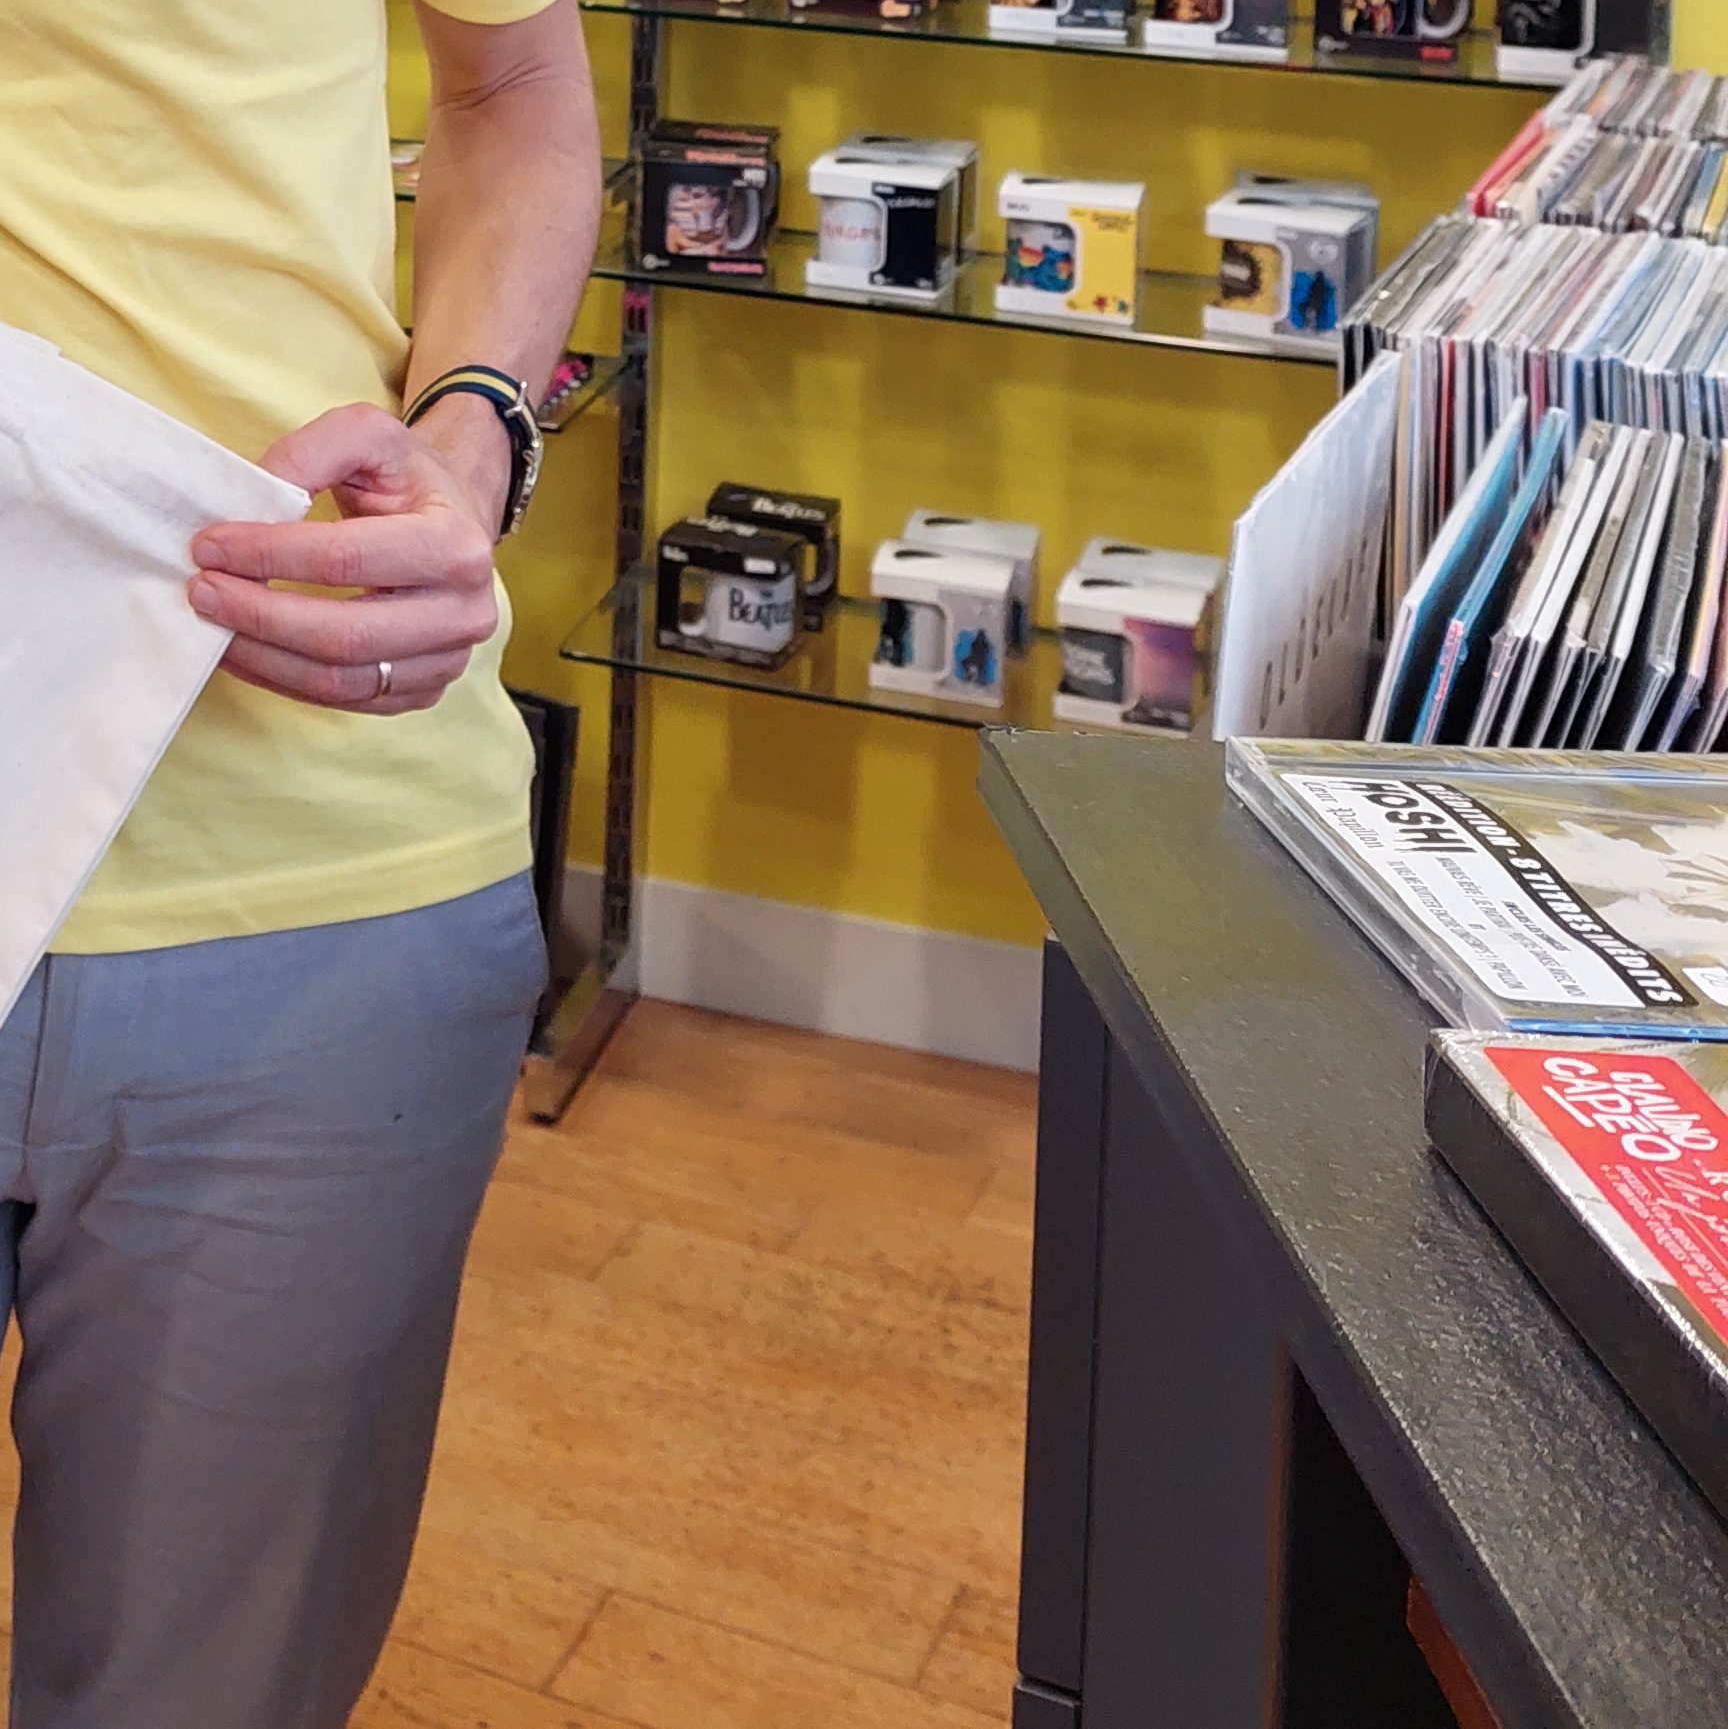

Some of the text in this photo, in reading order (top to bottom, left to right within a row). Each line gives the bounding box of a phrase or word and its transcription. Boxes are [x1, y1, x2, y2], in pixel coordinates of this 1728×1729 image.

[1326, 806, 1385, 849] Papillon
[1328, 780, 1478, 854] HOSHI
[1508, 857, 1542, 871] 8
[1522, 871, 1603, 934] TITRES
[1581, 931, 1684, 1004] INÉDITS
